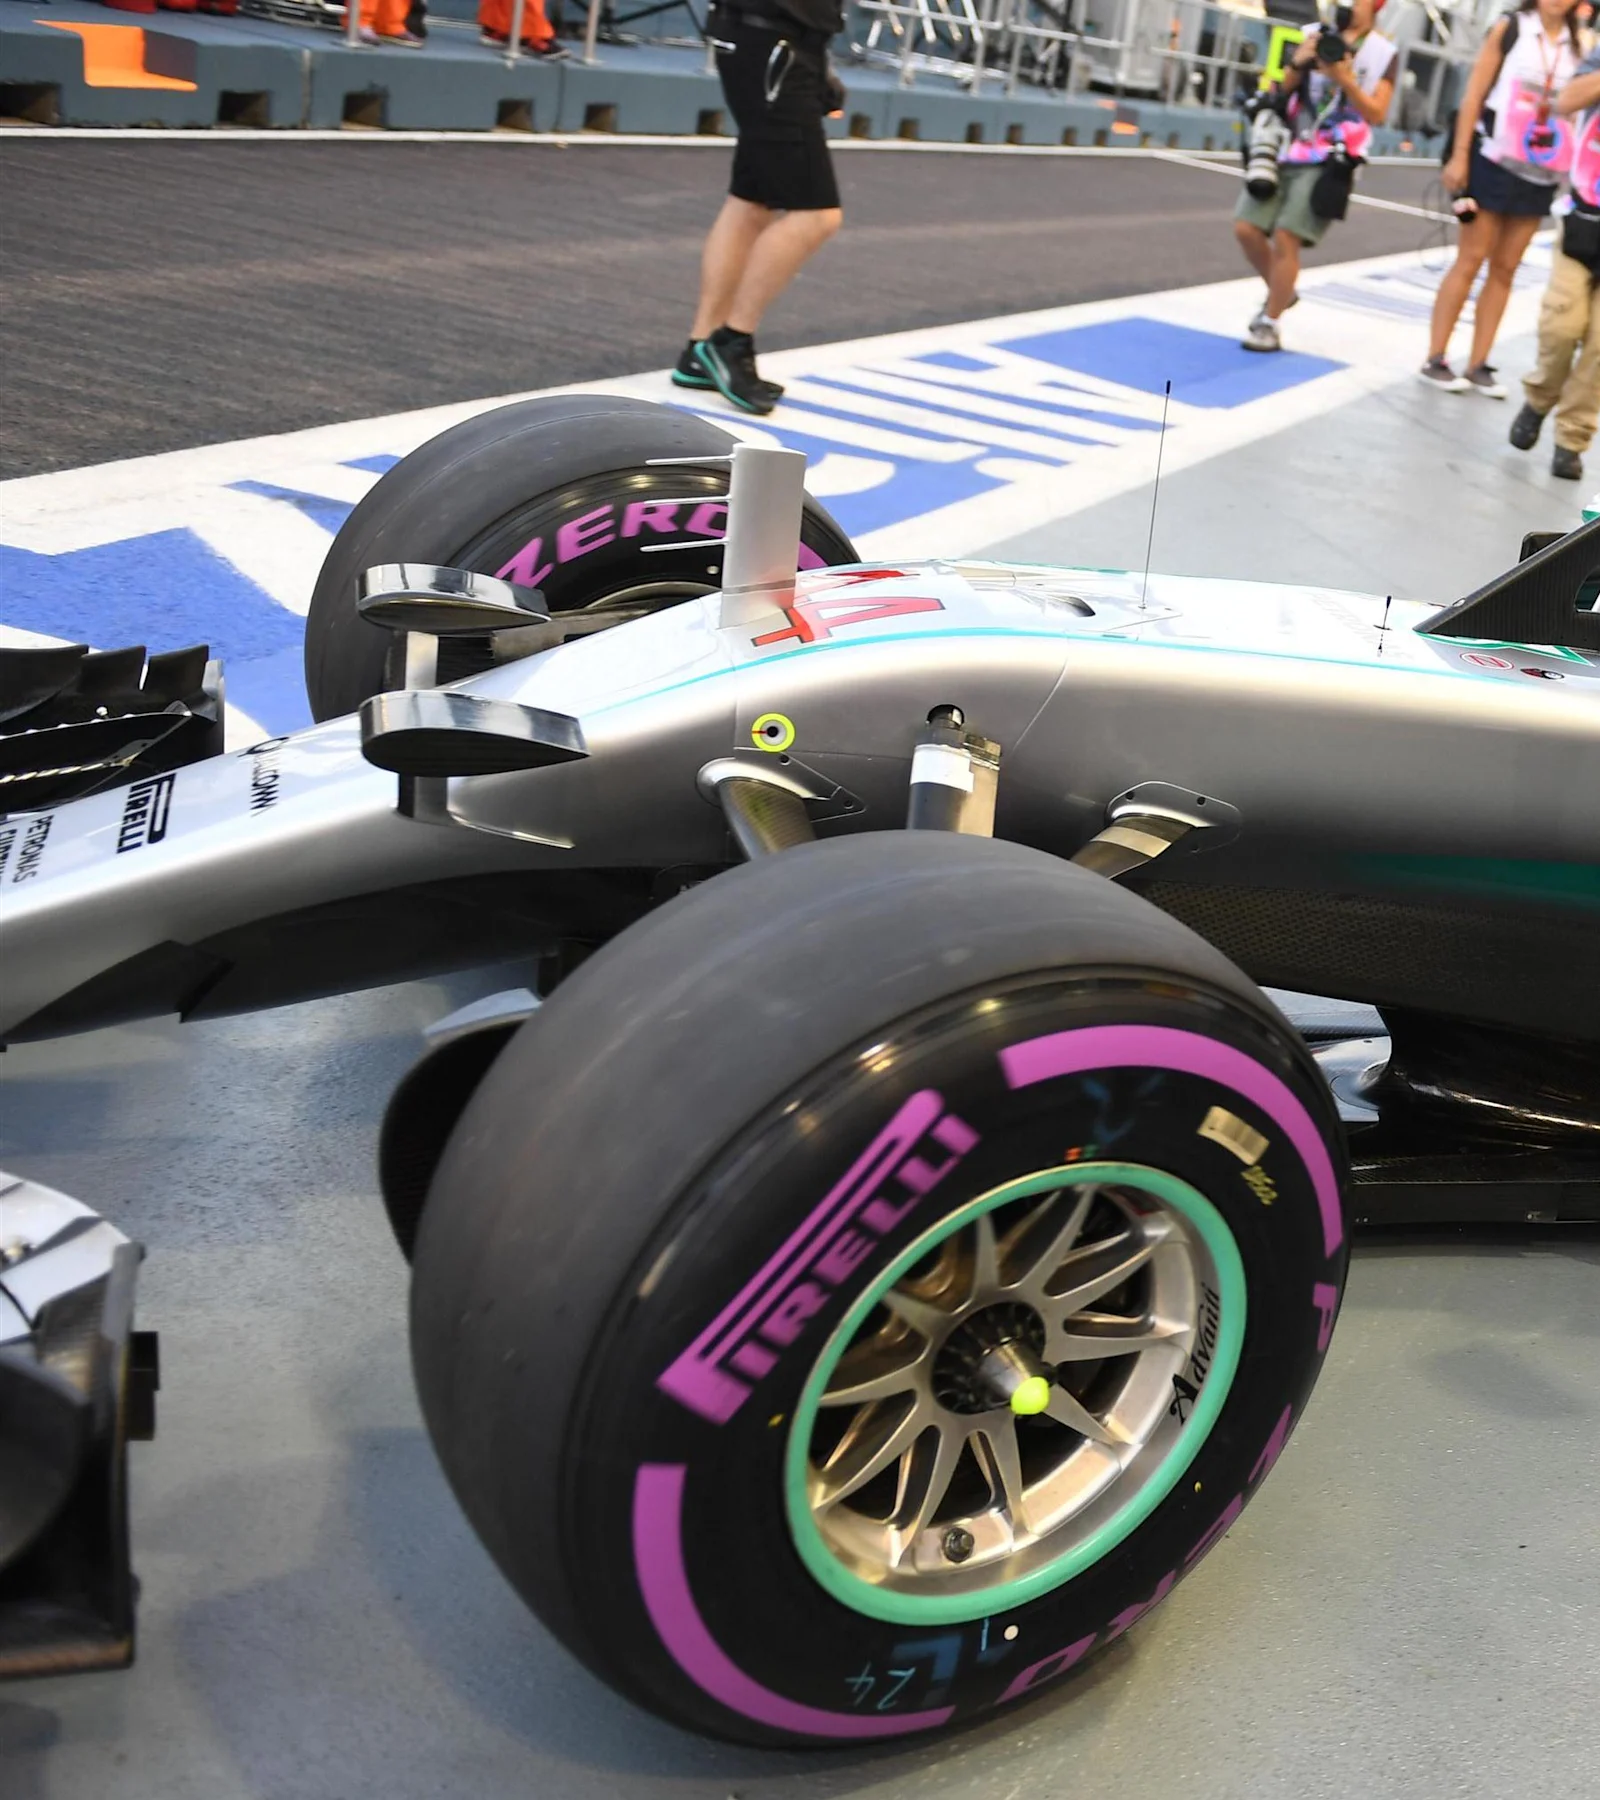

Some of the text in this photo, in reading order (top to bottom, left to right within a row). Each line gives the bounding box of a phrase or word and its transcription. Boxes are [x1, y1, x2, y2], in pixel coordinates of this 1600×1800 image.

[12, 814, 54, 883] PETRONAS
[117, 773, 177, 855] PIRELLI
[656, 1088, 981, 1426] PIRELLI
